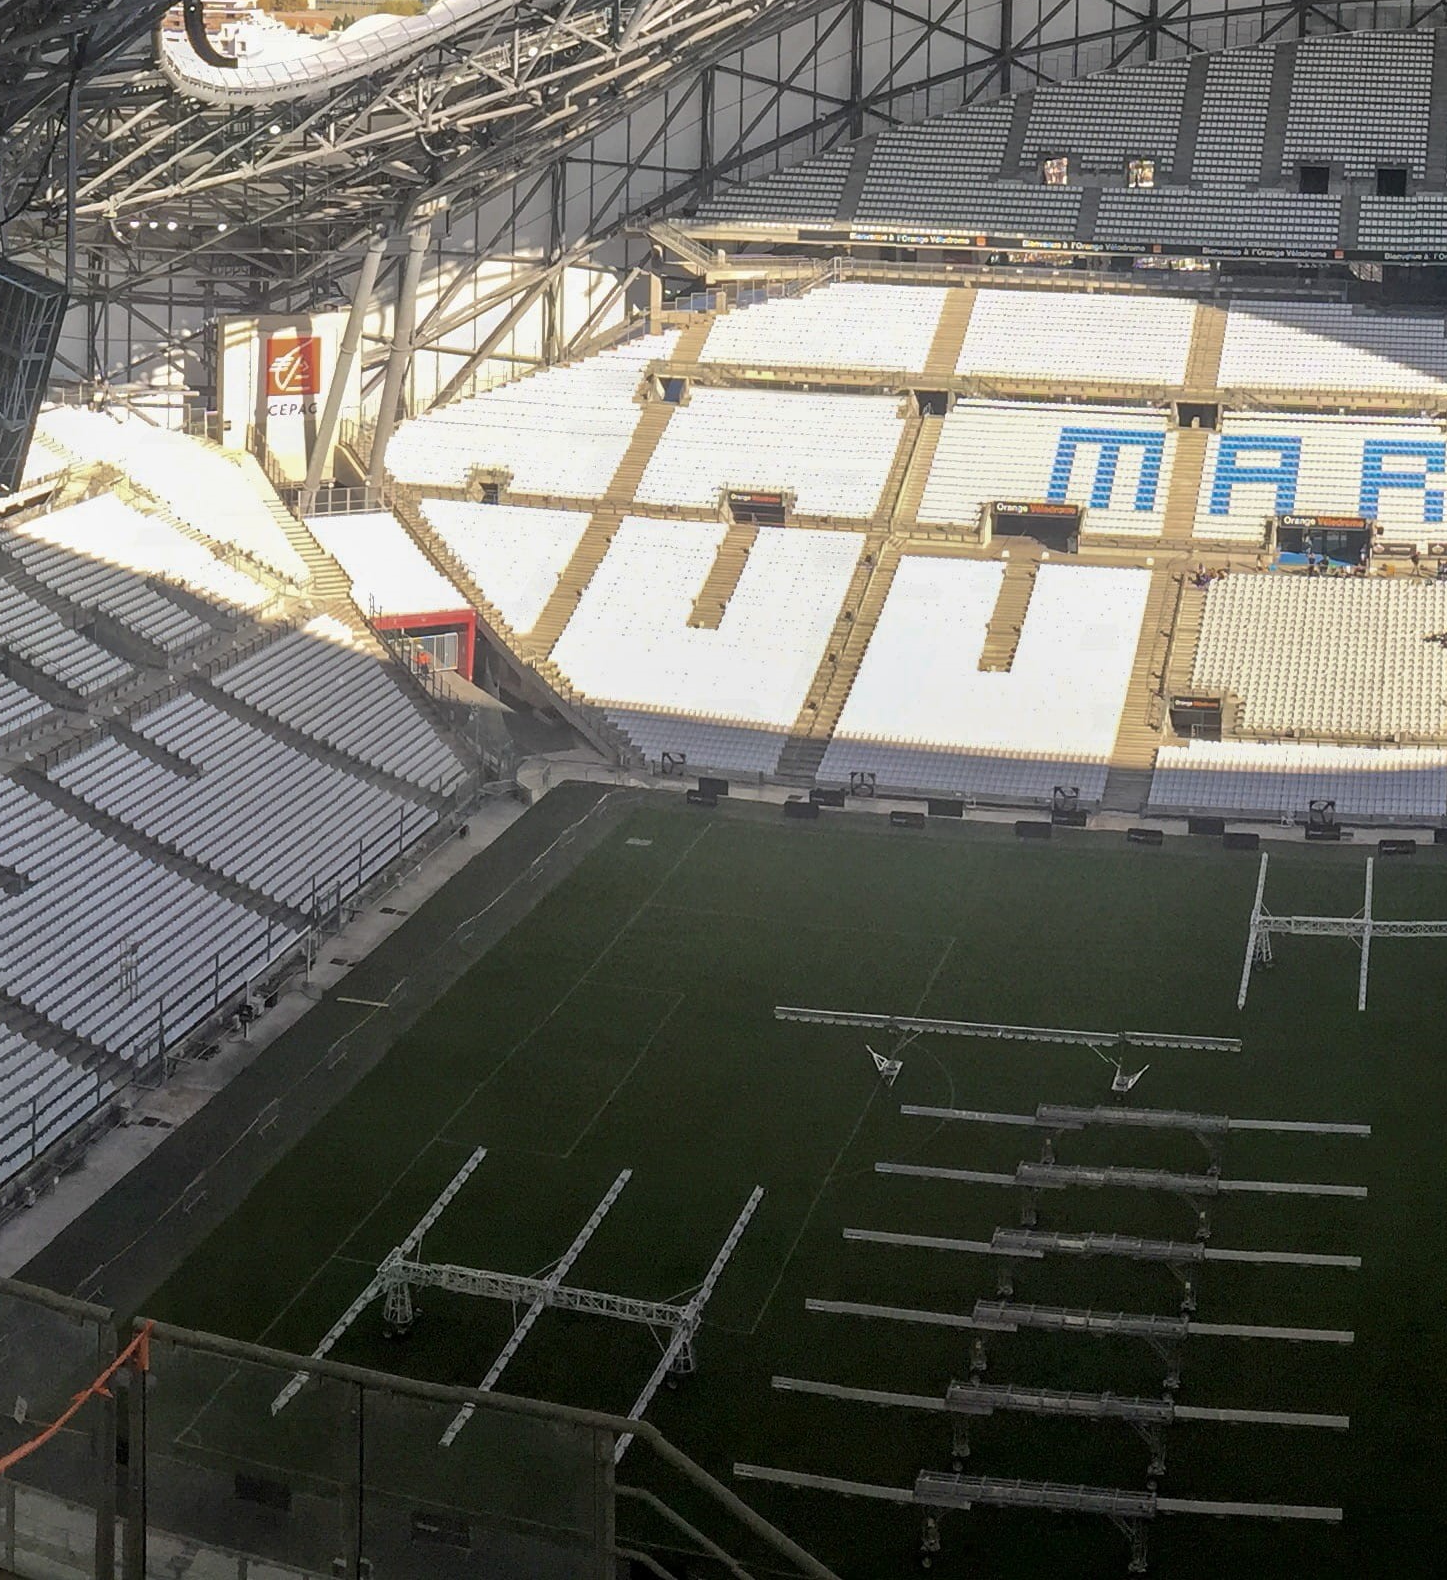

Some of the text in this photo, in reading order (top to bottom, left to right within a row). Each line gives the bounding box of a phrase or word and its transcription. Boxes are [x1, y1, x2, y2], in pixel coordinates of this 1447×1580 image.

[268, 403, 317, 416] CEPAC
[996, 502, 1028, 514] Orange
[1283, 516, 1316, 527] Orange
